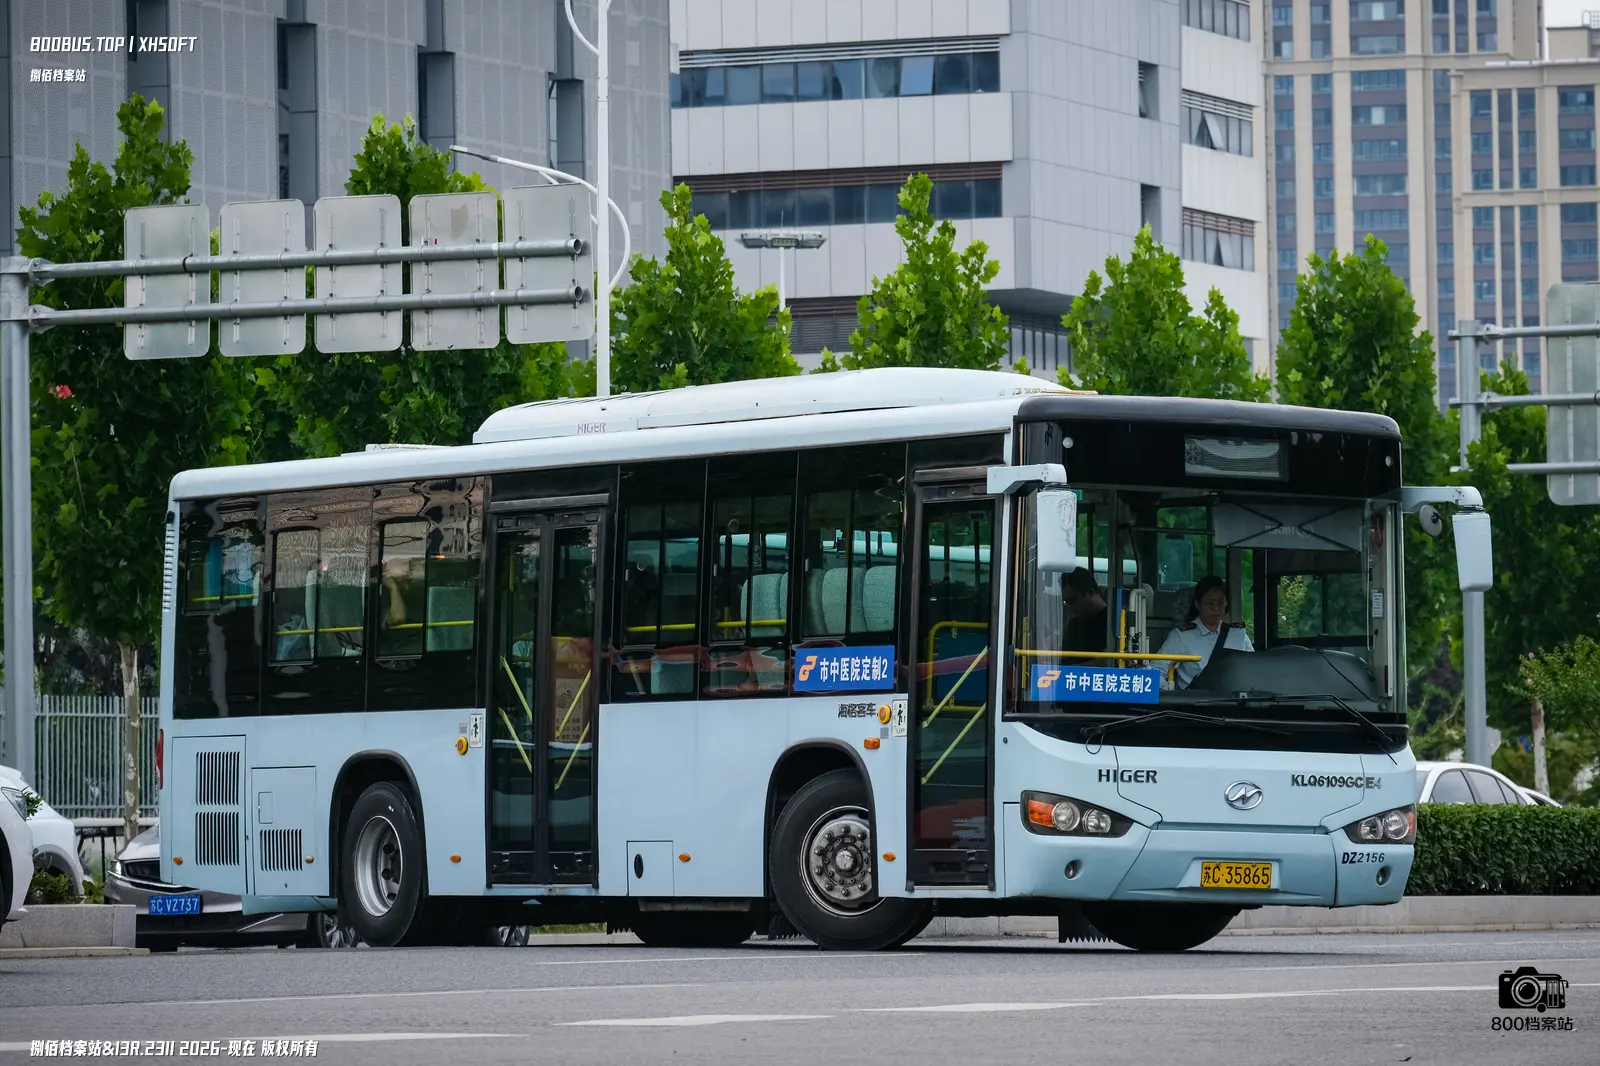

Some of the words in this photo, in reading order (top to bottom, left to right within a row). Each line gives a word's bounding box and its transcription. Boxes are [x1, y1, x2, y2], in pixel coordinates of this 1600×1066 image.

[577, 421, 606, 434] HIGER
[820, 656, 888, 682] 市中医院定制2
[1065, 672, 1152, 693] 市中医院定制2
[1098, 769, 1157, 784] HIGER
[1342, 852, 1386, 864] DZ2156
